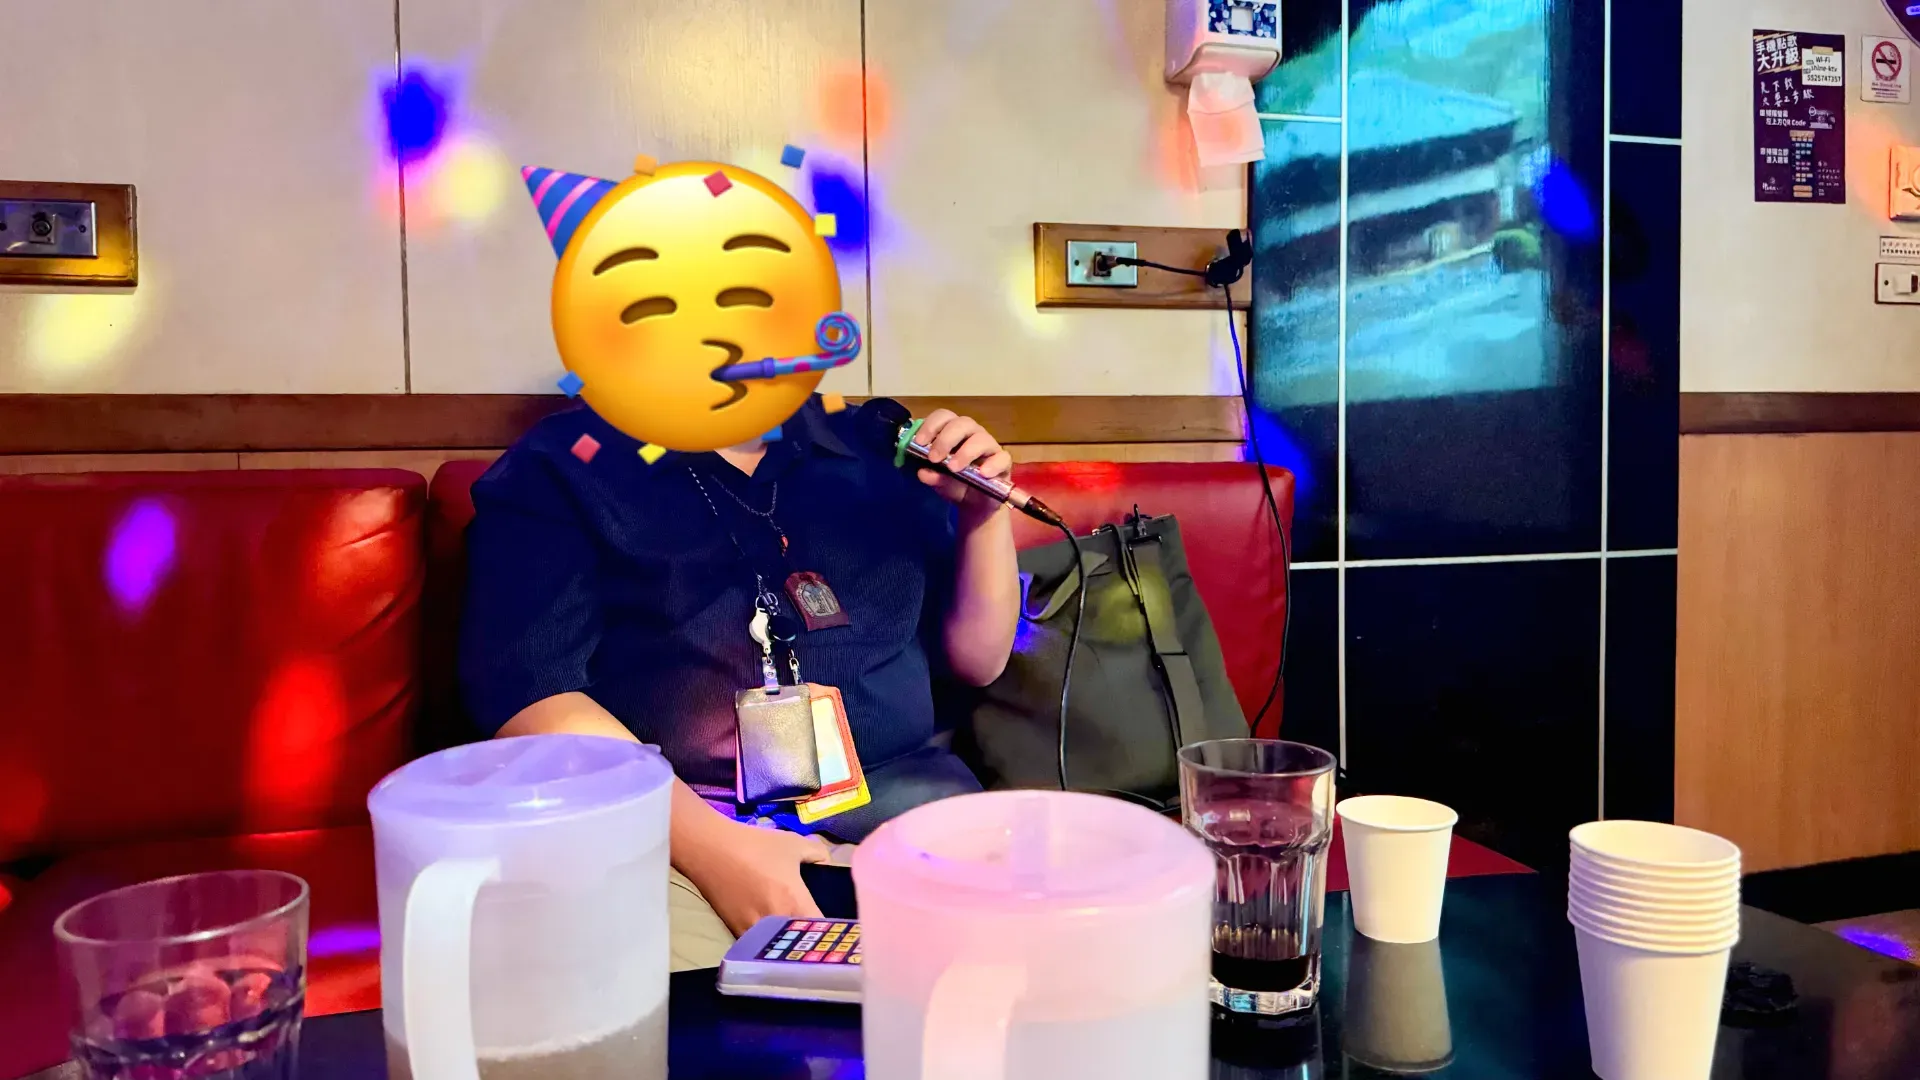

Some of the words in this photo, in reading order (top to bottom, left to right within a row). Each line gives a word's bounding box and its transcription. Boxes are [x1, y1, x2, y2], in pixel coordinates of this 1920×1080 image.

[1755, 35, 1798, 55] 手機點歌
[1757, 47, 1800, 72] 大升級
